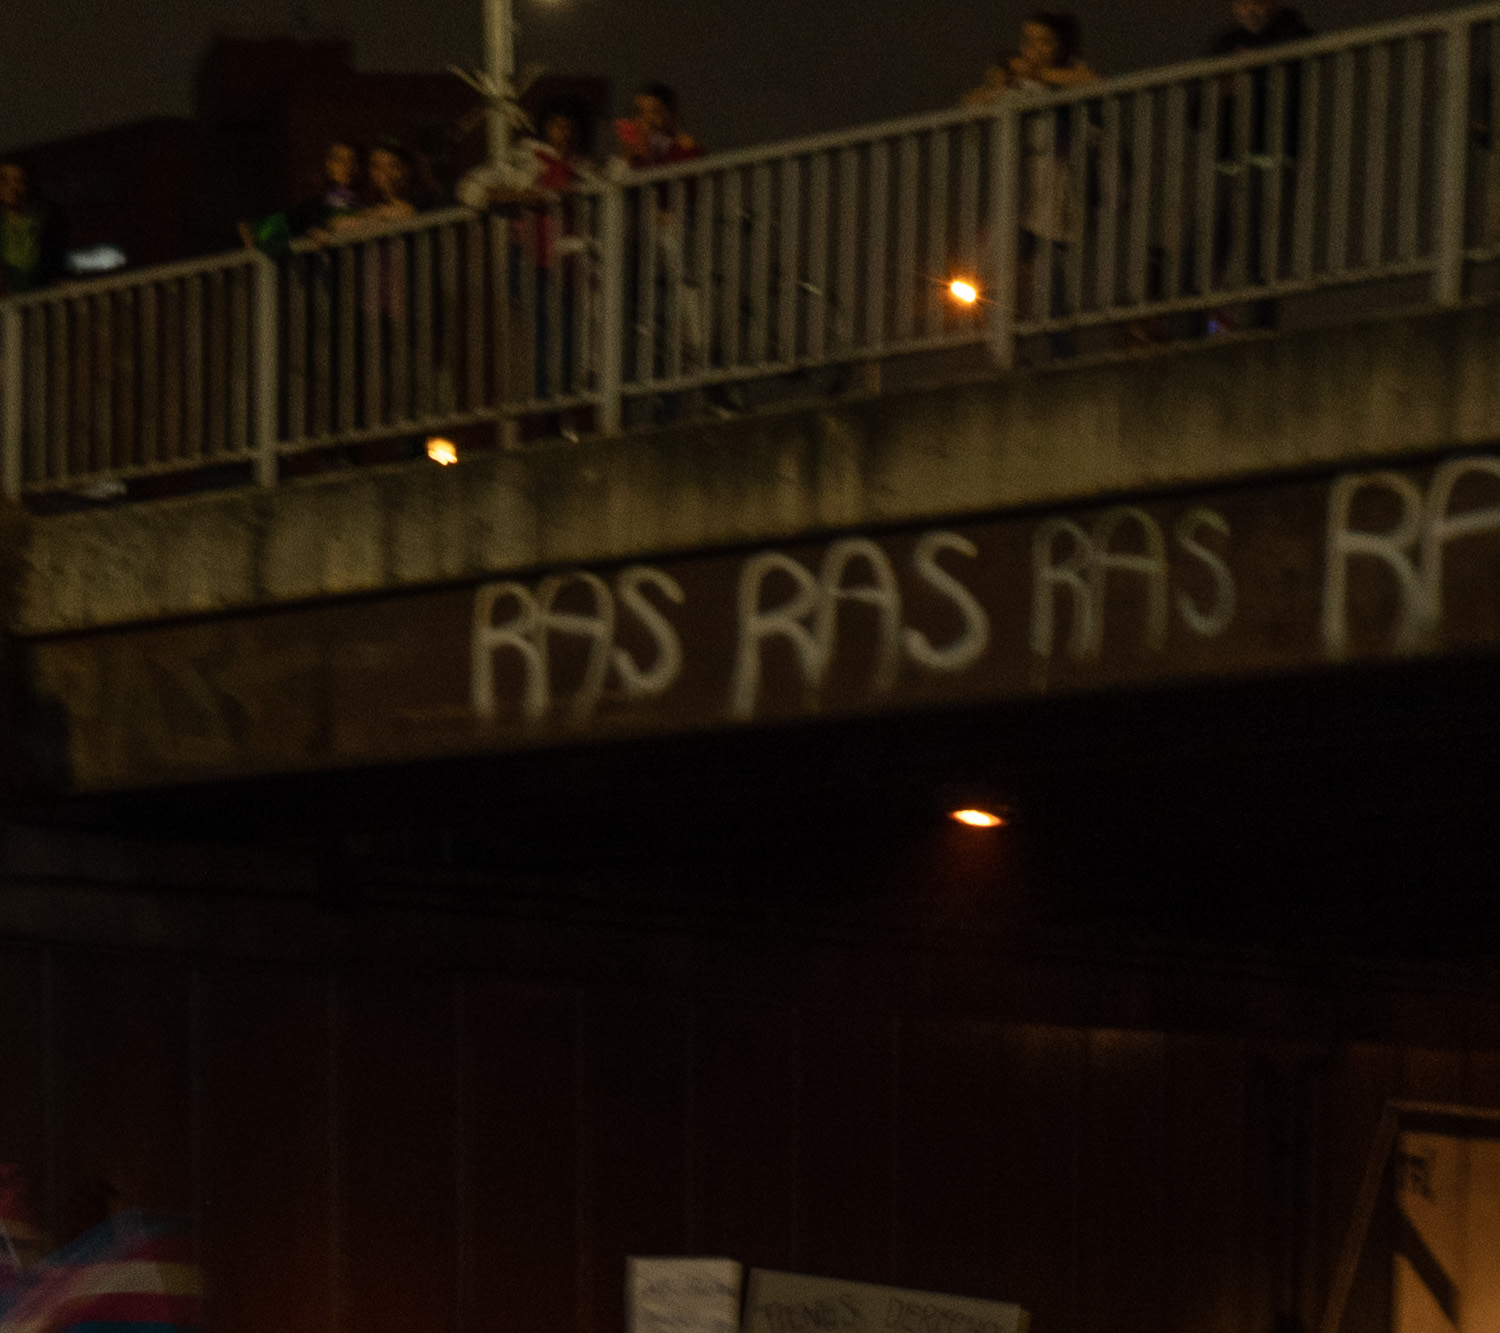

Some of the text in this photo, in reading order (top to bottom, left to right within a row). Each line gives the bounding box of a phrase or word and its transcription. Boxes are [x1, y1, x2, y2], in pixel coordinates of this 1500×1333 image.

[470, 562, 685, 722] RAS
[728, 529, 989, 720] RAS
[1030, 506, 1237, 685] RAS
